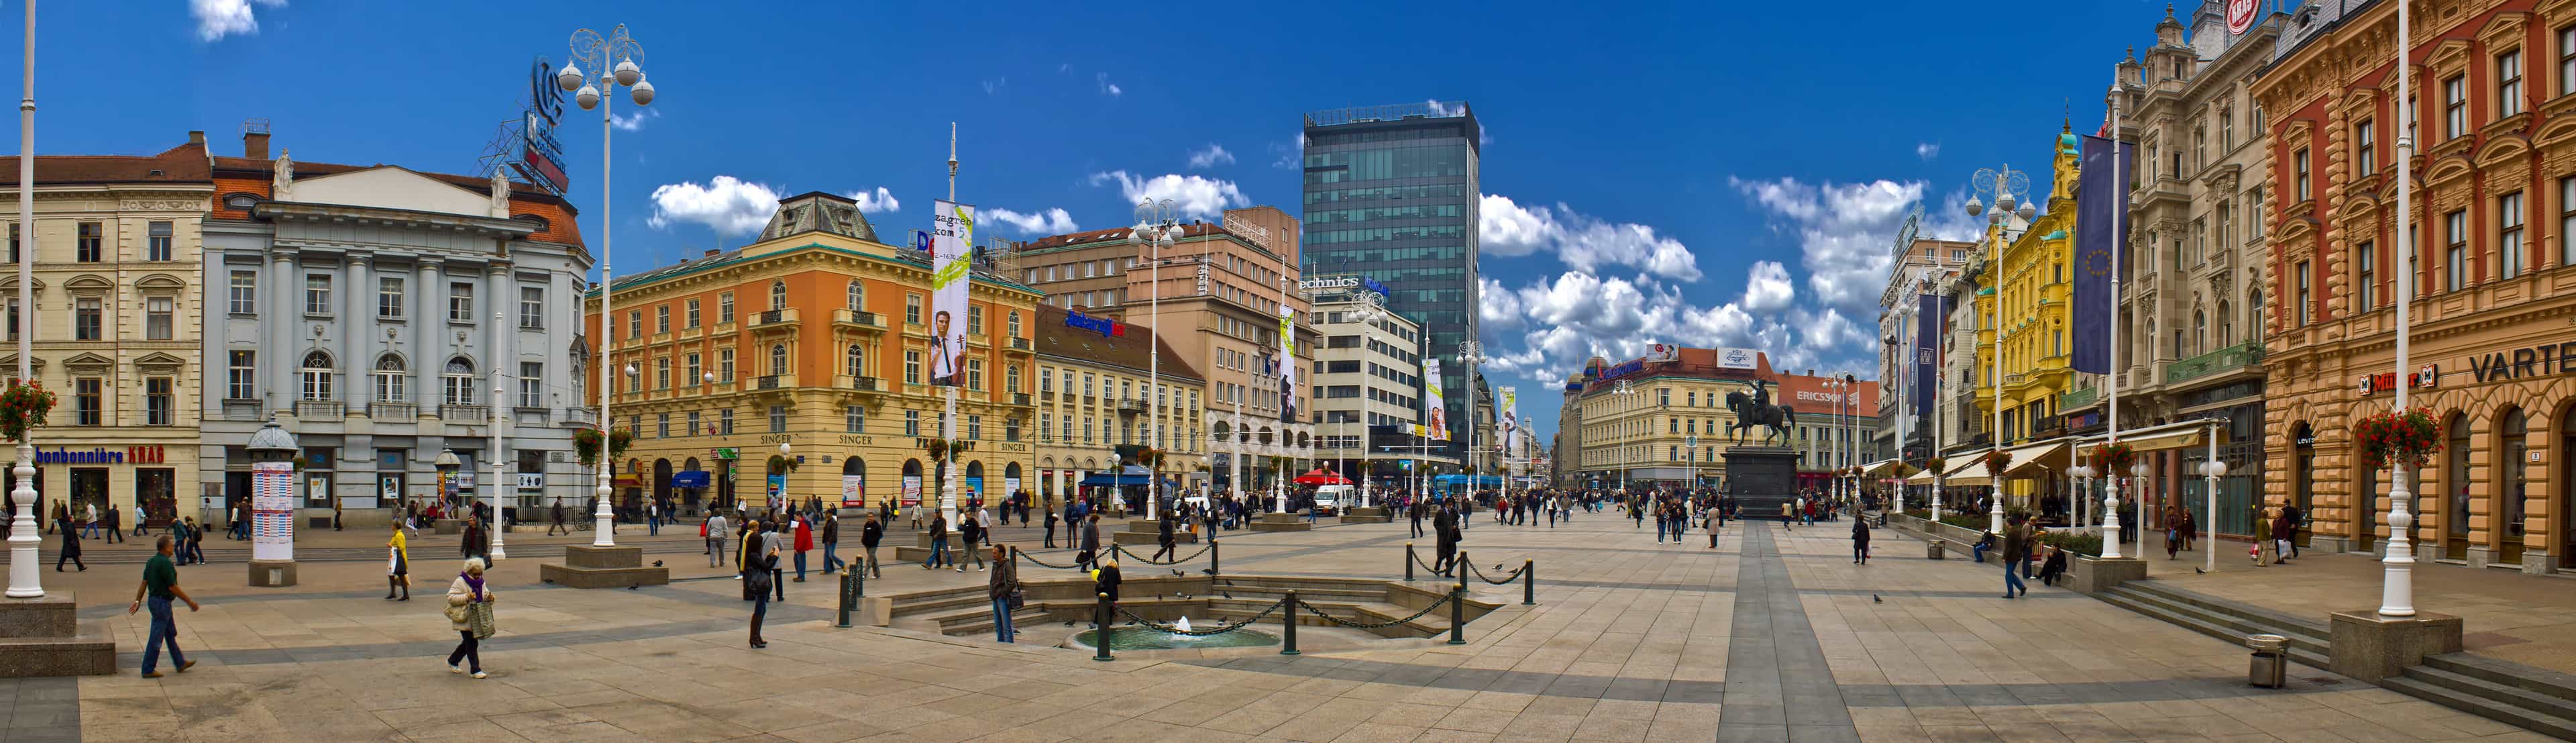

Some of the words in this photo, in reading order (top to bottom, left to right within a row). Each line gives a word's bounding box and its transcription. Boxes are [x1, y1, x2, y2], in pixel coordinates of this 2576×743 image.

[934, 214, 972, 227] zagreb
[934, 226, 954, 237] kom
[1299, 276, 1358, 290] echnics
[2469, 341, 2576, 383] VARTE
[761, 434, 792, 444] SINGER
[839, 435, 873, 445] SINGER
[1001, 442, 1026, 452] SINGER
[36, 446, 123, 463] bonbonnière
